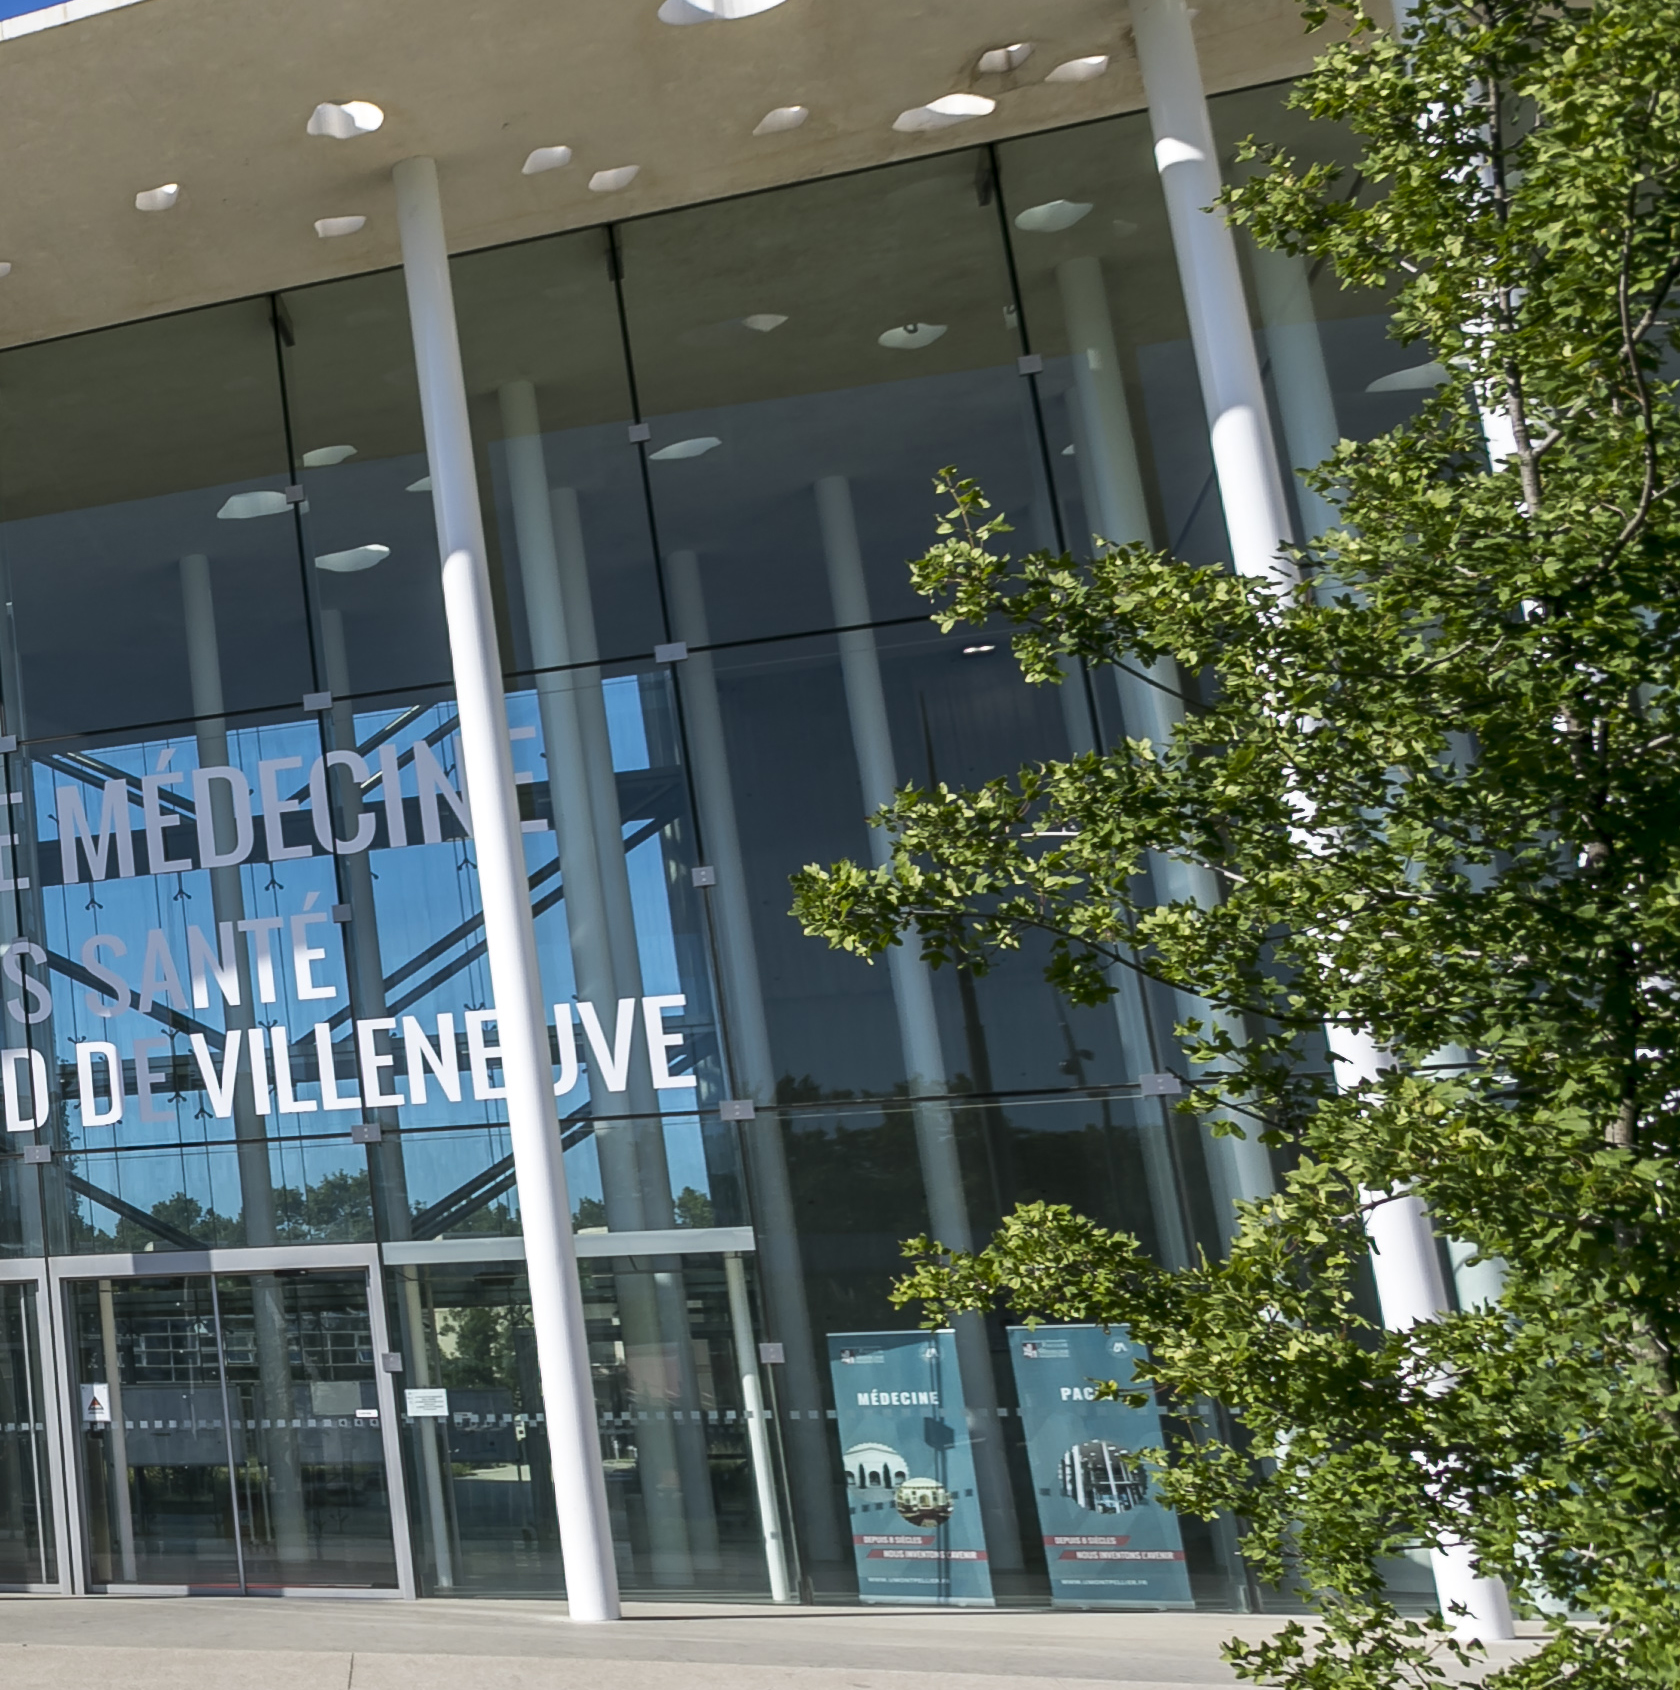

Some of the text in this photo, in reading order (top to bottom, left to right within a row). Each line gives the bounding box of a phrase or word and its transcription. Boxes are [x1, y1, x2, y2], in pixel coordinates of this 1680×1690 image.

[81, 891, 337, 1019] SANTÉ
[75, 1037, 176, 1127] DE
[857, 1389, 939, 1406] MÉDECINE
[1059, 1386, 1115, 1402] PAC
